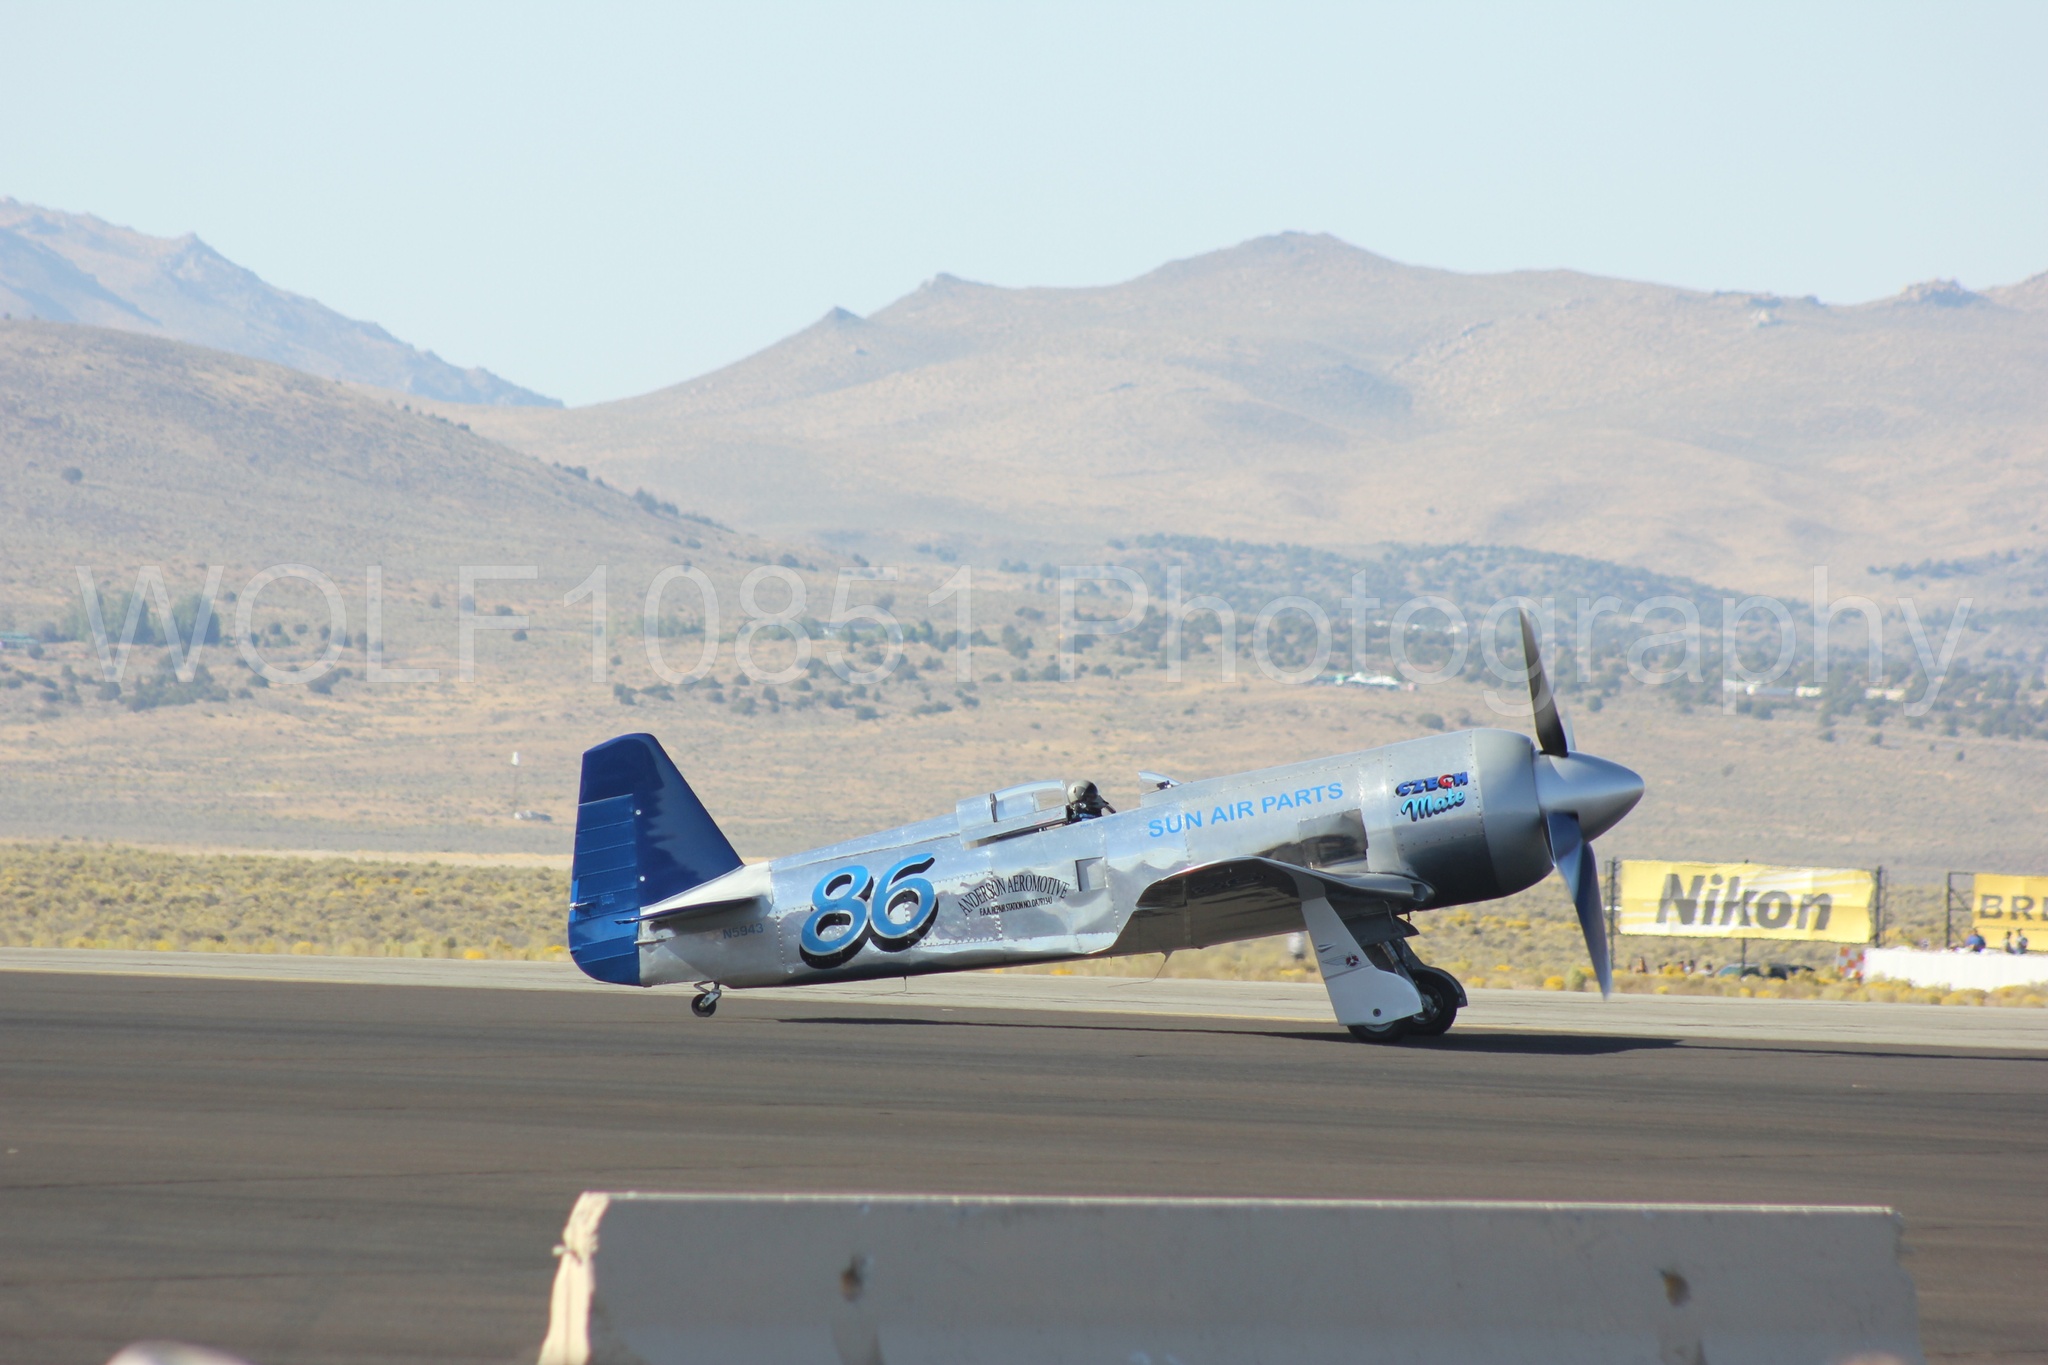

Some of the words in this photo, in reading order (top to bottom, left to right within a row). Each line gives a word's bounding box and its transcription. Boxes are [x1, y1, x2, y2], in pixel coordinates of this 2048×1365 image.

[1395, 771, 1469, 797] CZECH
[1148, 810, 1203, 838] SUN
[1210, 801, 1255, 825] AIR
[1261, 782, 1344, 814] PARTS
[1400, 787, 1466, 822] Mate
[799, 853, 940, 969] 86
[958, 877, 1006, 916] ANDERSON
[1008, 874, 1070, 899] AEROMOTIVE
[1005, 901, 1023, 912] STATION
[1656, 873, 1833, 931] Nikon
[1979, 894, 2048, 921] BR
[722, 922, 764, 939] N5943
